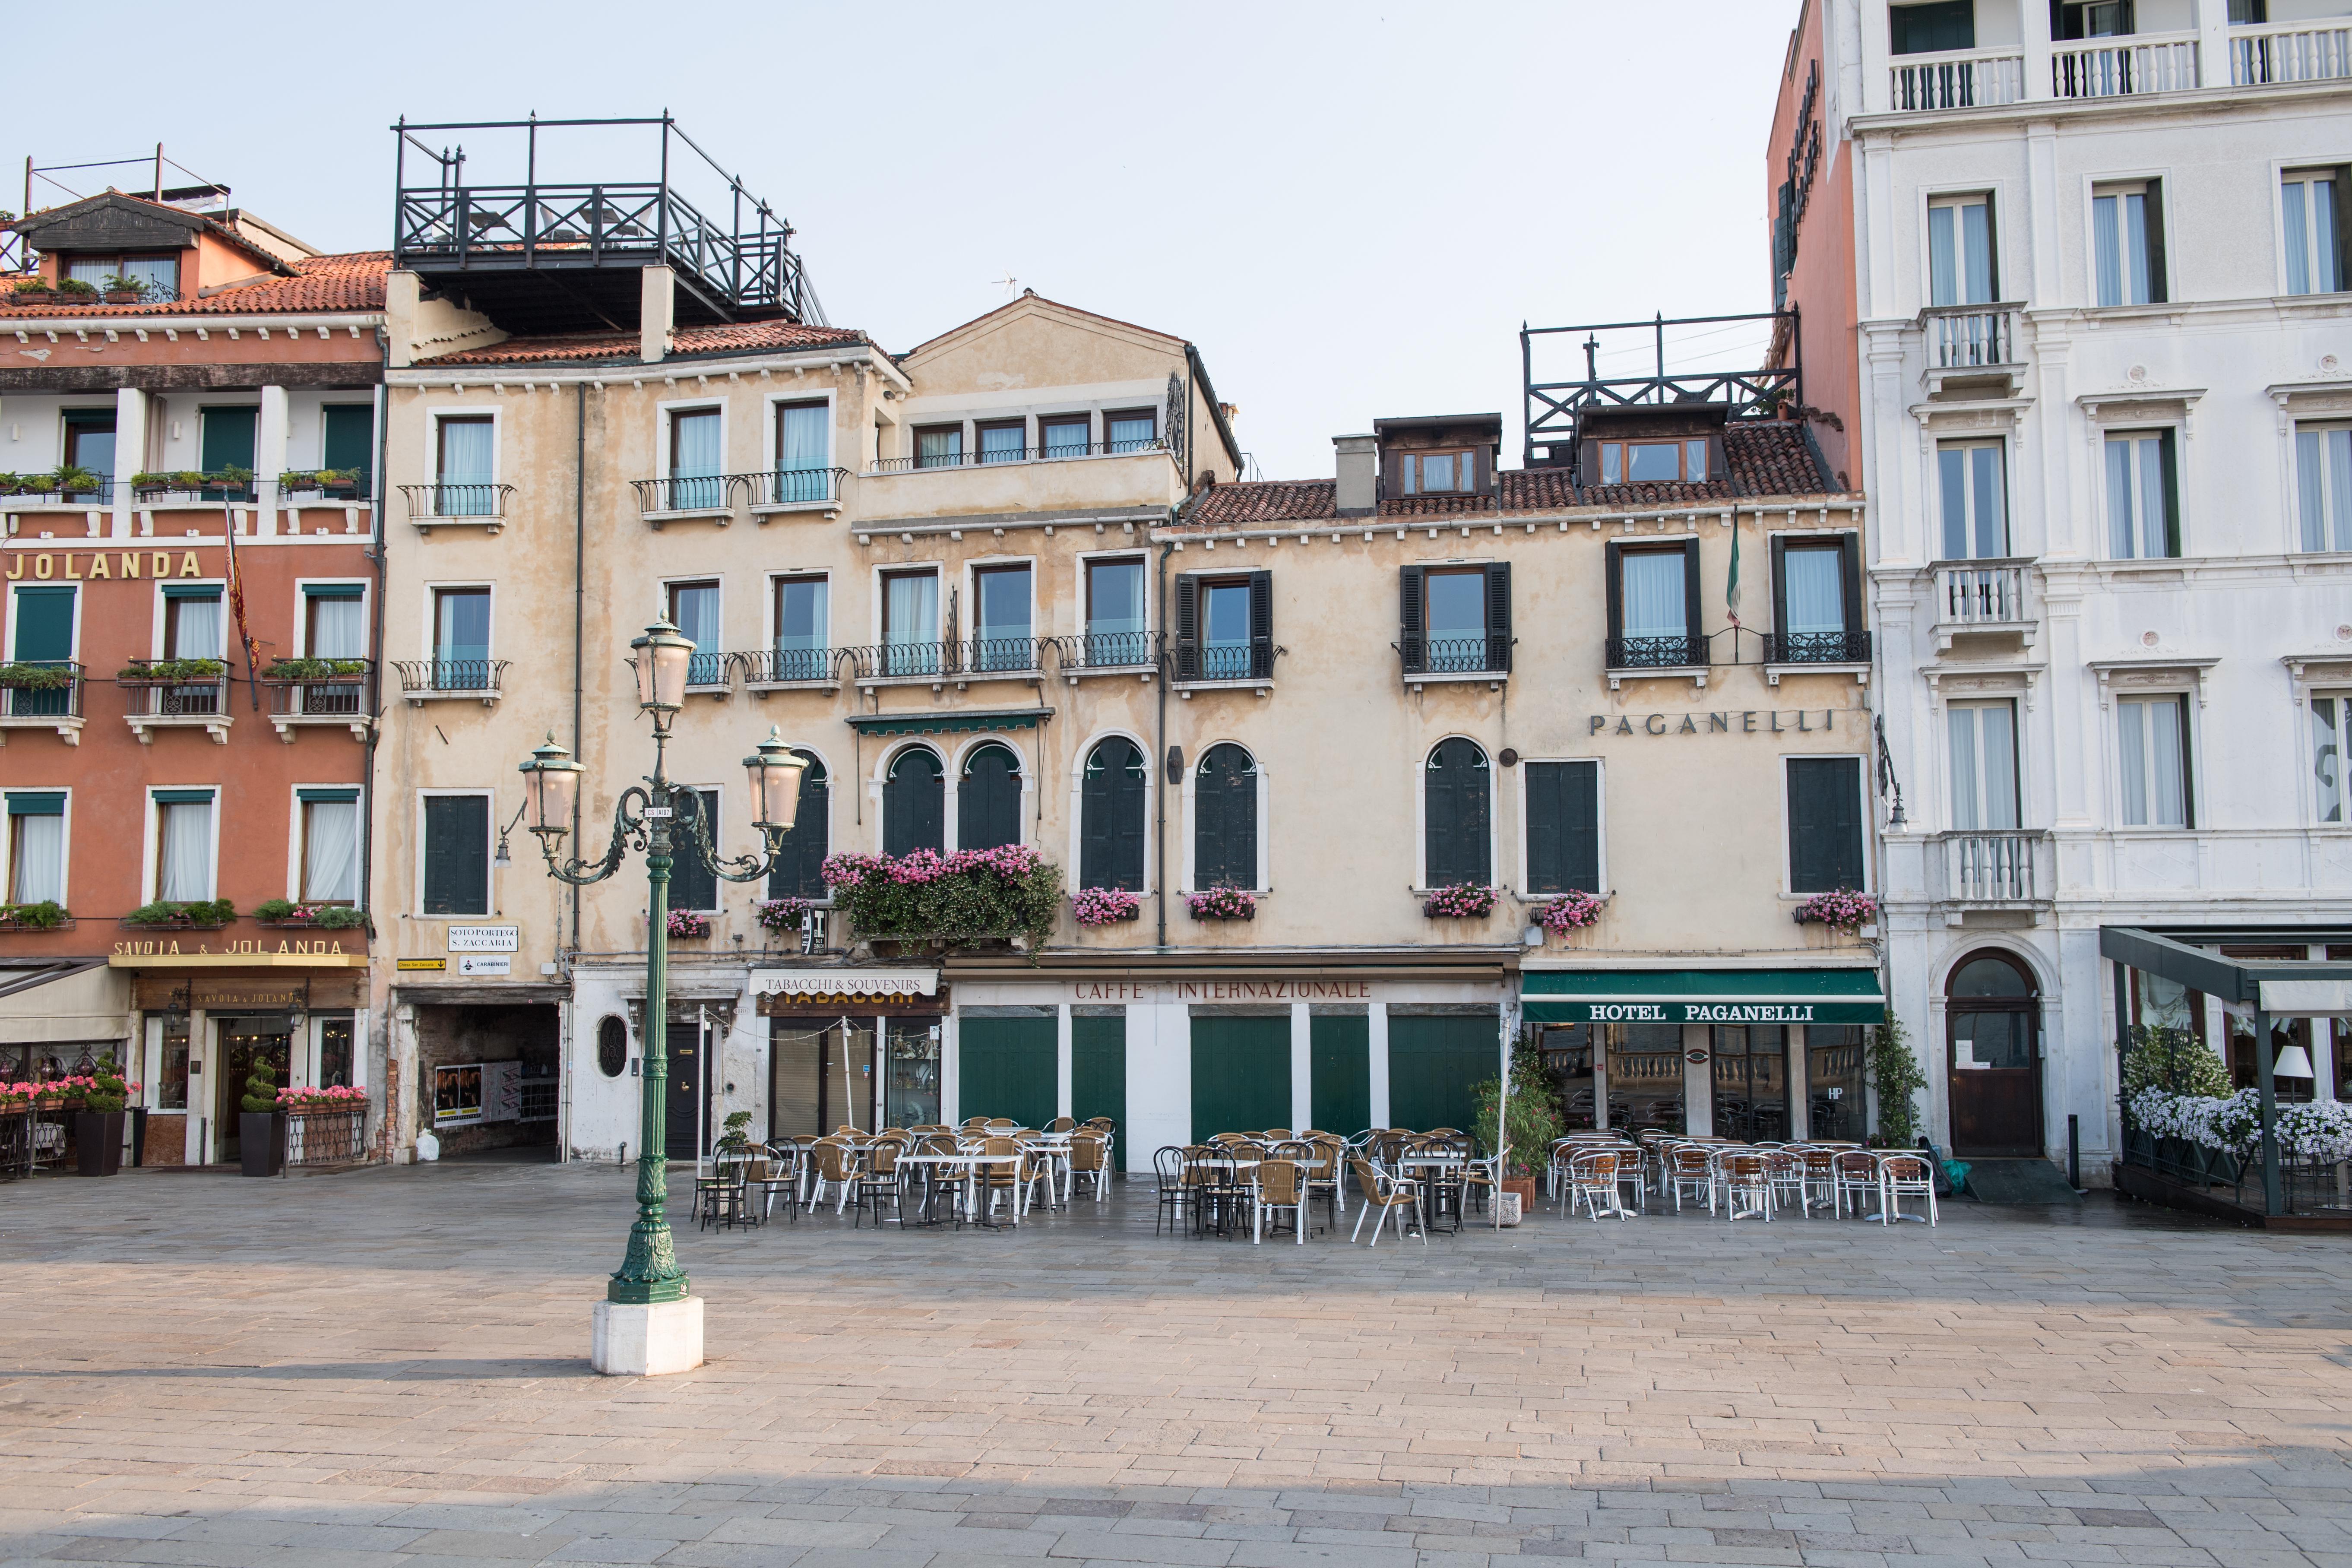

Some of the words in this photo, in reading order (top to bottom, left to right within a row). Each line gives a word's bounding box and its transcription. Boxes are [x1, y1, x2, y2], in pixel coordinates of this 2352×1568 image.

[5, 551, 202, 580] JOLANDA
[1590, 709, 1833, 736] PAGANELLI
[114, 940, 180, 955] SAVOIA
[199, 944, 208, 954] &
[766, 979, 832, 990] TABACCHI
[835, 979, 844, 990] &
[848, 979, 920, 990] SOUVENIRS
[1178, 981, 1371, 998] INTERNAZIONALE
[197, 995, 238, 1003] SAVOIA
[252, 994, 301, 1003] JOLANDA
[1589, 1005, 1666, 1020] HOTEL
[1684, 1005, 1814, 1021] PAGANELLI
[1828, 1088, 1842, 1099] HP
